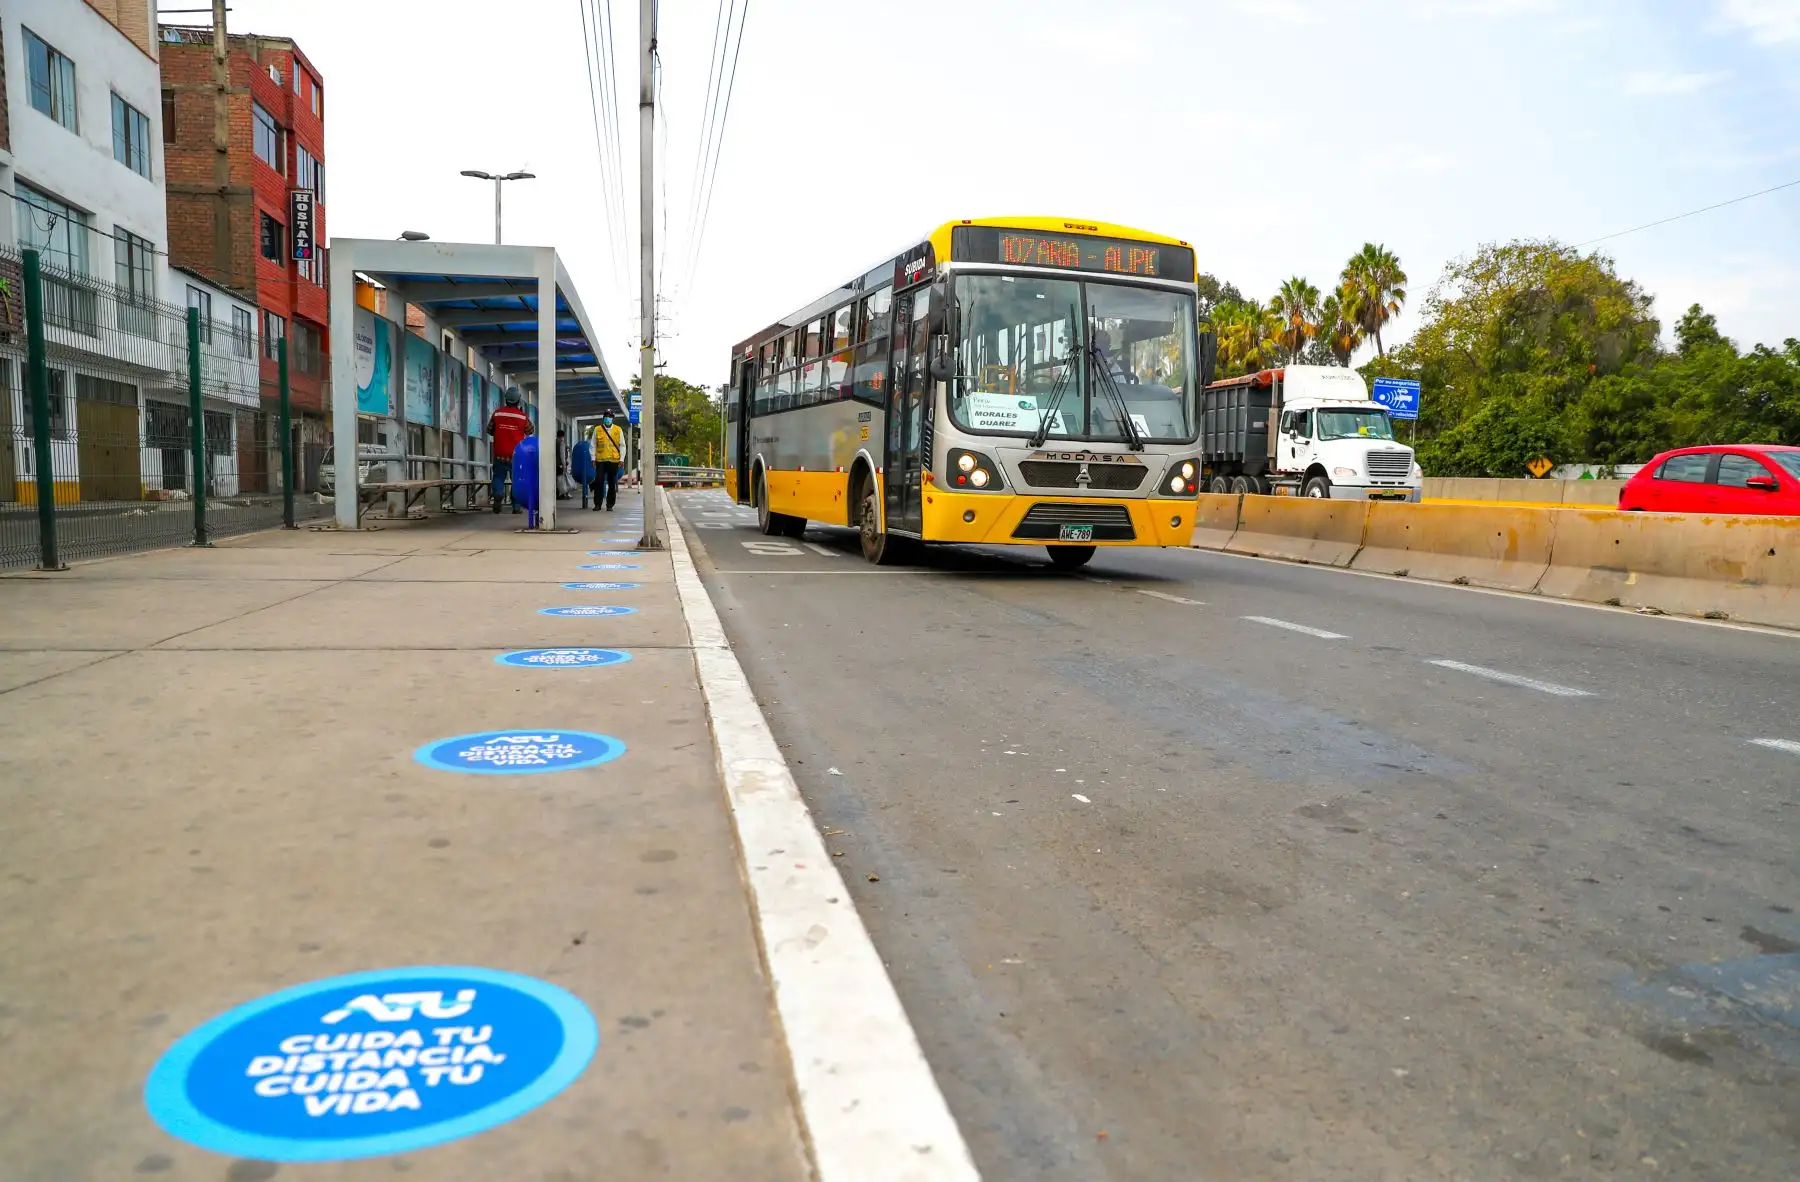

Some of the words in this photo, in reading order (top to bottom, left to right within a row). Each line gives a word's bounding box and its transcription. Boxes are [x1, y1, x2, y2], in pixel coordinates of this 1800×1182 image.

[295, 193, 311, 247] HOSTAL
[904, 256, 926, 276] SUBIDA
[974, 410, 1018, 419] MORALES
[1046, 453, 1125, 463] MODASA
[320, 988, 477, 1025] ATU
[279, 1029, 424, 1055] CUIDA
[432, 1024, 493, 1047] TU
[245, 1043, 507, 1077] DISTANCIA,
[254, 1068, 410, 1097] CUIDA
[419, 1063, 485, 1088] TU
[303, 1088, 422, 1118] VIDA
